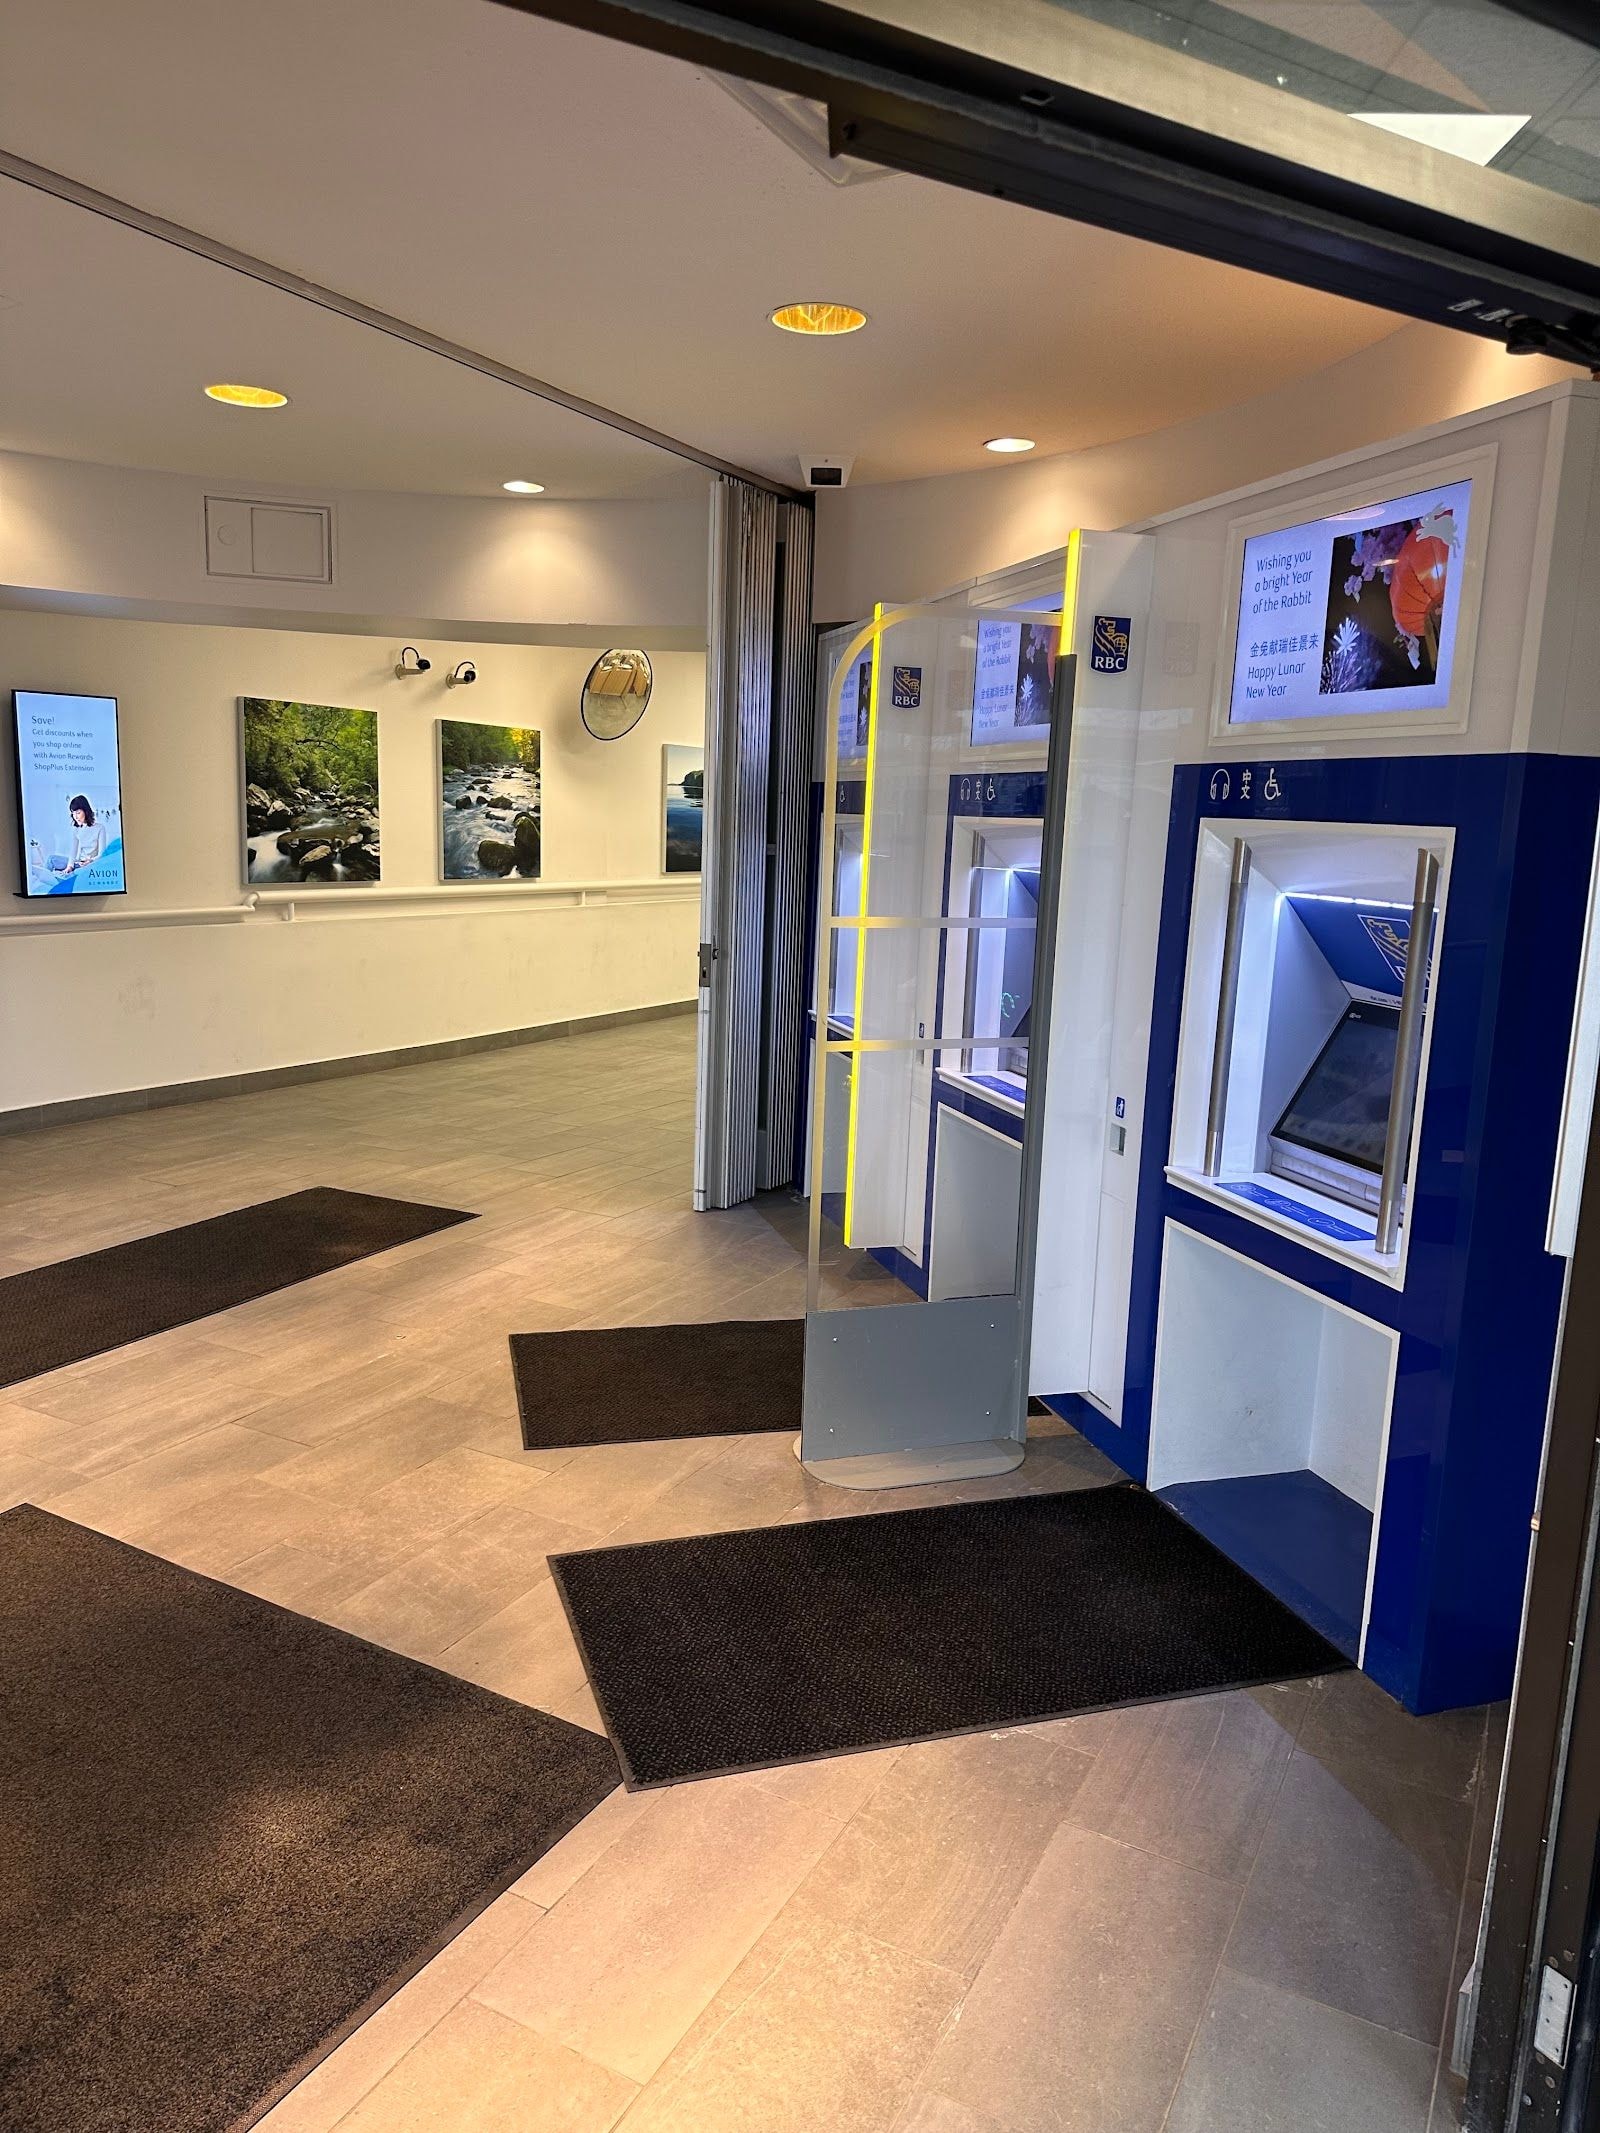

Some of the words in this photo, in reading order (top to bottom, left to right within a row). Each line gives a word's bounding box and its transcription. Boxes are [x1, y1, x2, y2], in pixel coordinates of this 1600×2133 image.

[1256, 553, 1293, 572] Wishing
[1294, 550, 1312, 568] you
[1254, 582, 1261, 593] a
[1263, 574, 1289, 593] bright
[1293, 570, 1313, 585] Year
[1253, 598, 1263, 614] of
[1264, 597, 1279, 612] the
[1281, 590, 1312, 608] Rabbit
[1094, 655, 1125, 670] RBC
[1248, 665, 1276, 682] Happy
[1278, 662, 1306, 676] Lunar
[1246, 685, 1265, 699] New
[1267, 683, 1287, 697] Year
[895, 695, 918, 706] RBC
[31, 715, 55, 725] Save!
[32, 728, 44, 736] Get
[45, 729, 76, 737] discounts
[77, 730, 94, 738] when
[33, 741, 45, 749] you
[46, 741, 62, 749] shop
[49, 752, 67, 760] Avion
[68, 753, 94, 761] Rewards
[34, 763, 63, 772] ShopPlus
[64, 764, 95, 772] Extension
[1240, 769, 1252, 799] 中文
[89, 869, 118, 878] AVION
